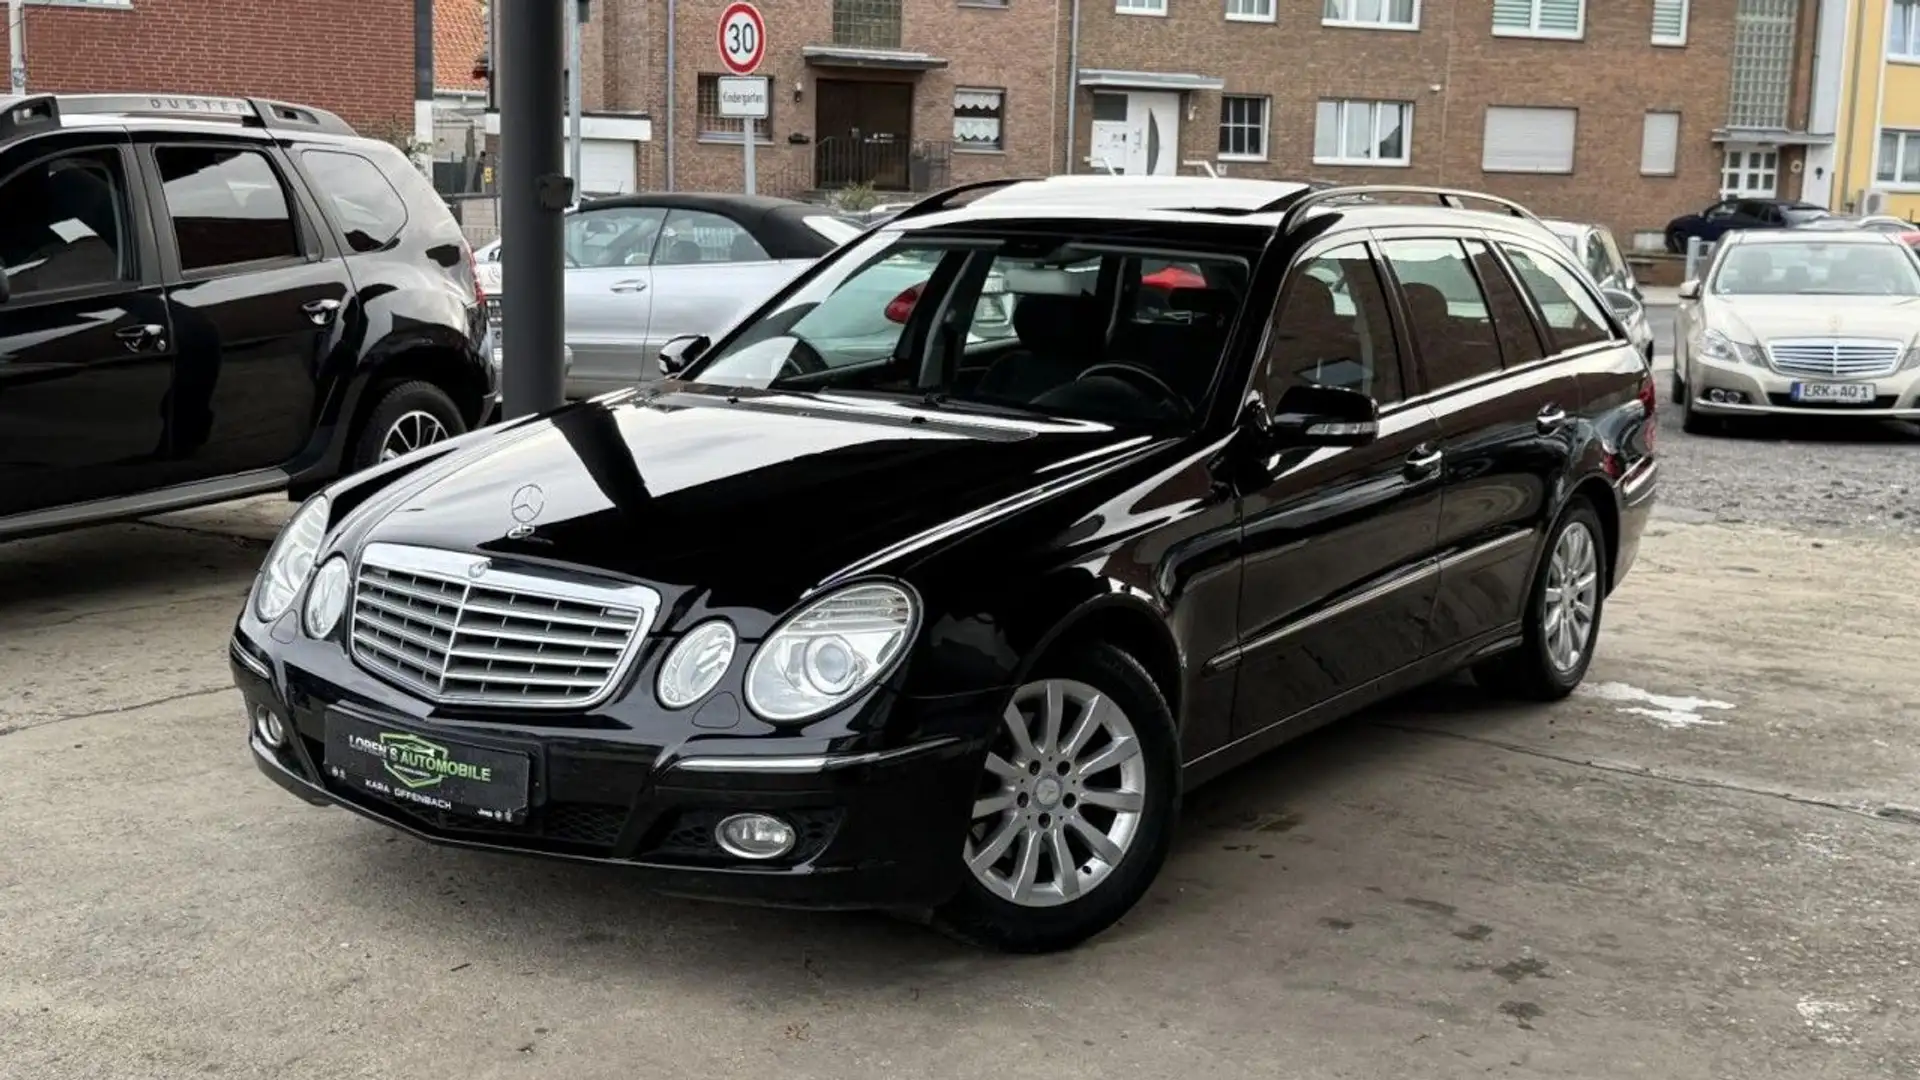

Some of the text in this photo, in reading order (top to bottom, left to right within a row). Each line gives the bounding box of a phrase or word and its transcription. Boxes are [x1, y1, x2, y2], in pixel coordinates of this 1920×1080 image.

[728, 22, 755, 54] 30
[150, 98, 247, 111] DUSTER
[722, 90, 764, 106] Kindergarten
[400, 749, 492, 782] AUTOMOBILE
[394, 787, 451, 810] OFFENBACH
